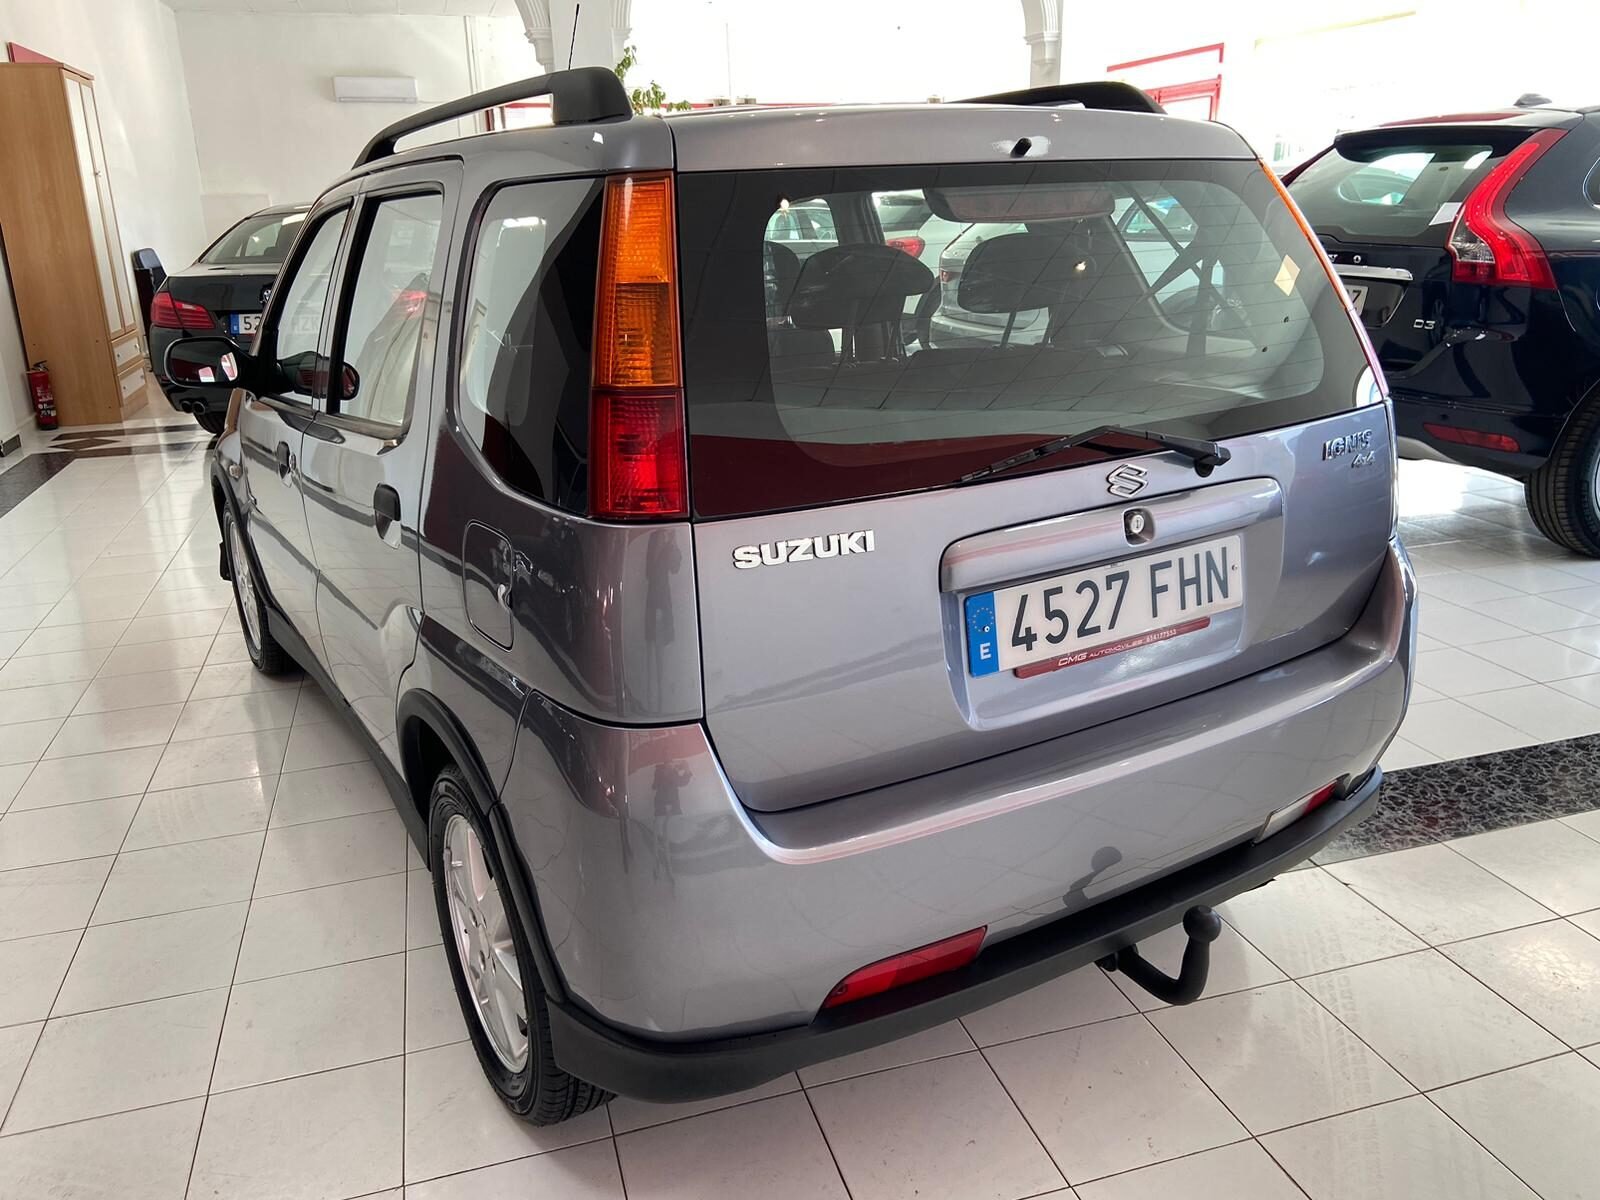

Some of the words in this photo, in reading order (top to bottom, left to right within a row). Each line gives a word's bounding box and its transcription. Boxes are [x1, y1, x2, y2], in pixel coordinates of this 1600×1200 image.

[1413, 319, 1435, 330] D3
[1322, 429, 1372, 461] IGNIS
[732, 529, 875, 569] SUZUKI
[1011, 570, 1130, 652] 4527
[1150, 546, 1230, 619] FHN
[980, 642, 992, 660] E
[1058, 652, 1088, 667] CMG
